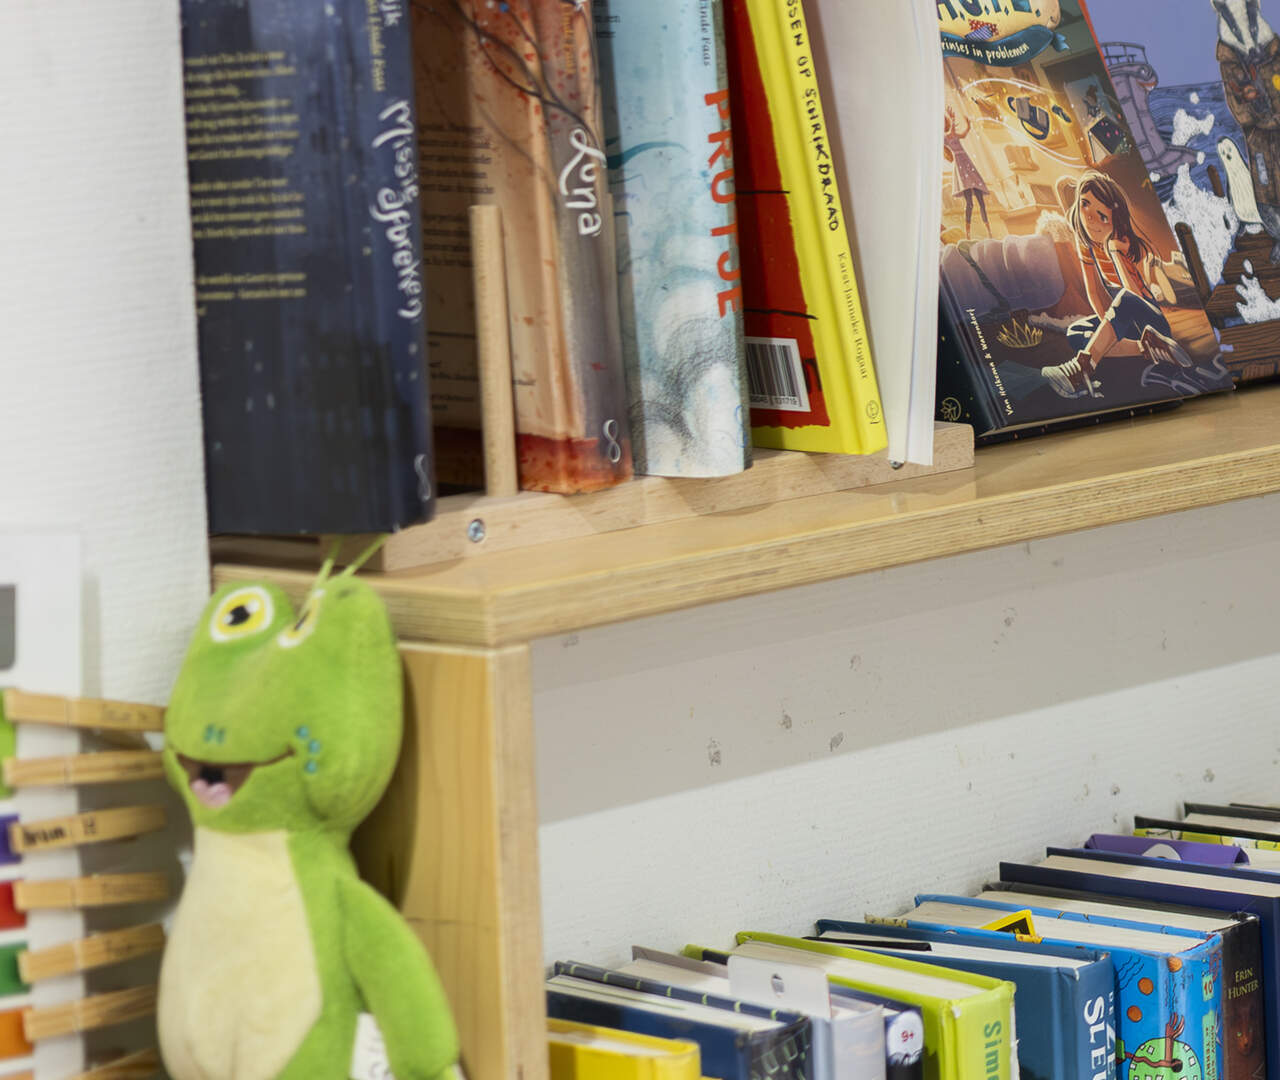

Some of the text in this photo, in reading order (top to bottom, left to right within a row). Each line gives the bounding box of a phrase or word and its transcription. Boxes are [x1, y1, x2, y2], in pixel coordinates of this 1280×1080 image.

[972, 43, 984, 59] in
[985, 42, 1031, 66] problemen
[796, 56, 812, 79] OP
[371, 99, 419, 204] Missie
[803, 87, 841, 232] SCHRIKDRAAD
[1203, 978, 1214, 996] 10
[1234, 967, 1254, 985] ERIN
[1227, 979, 1260, 1001] HUNTER
